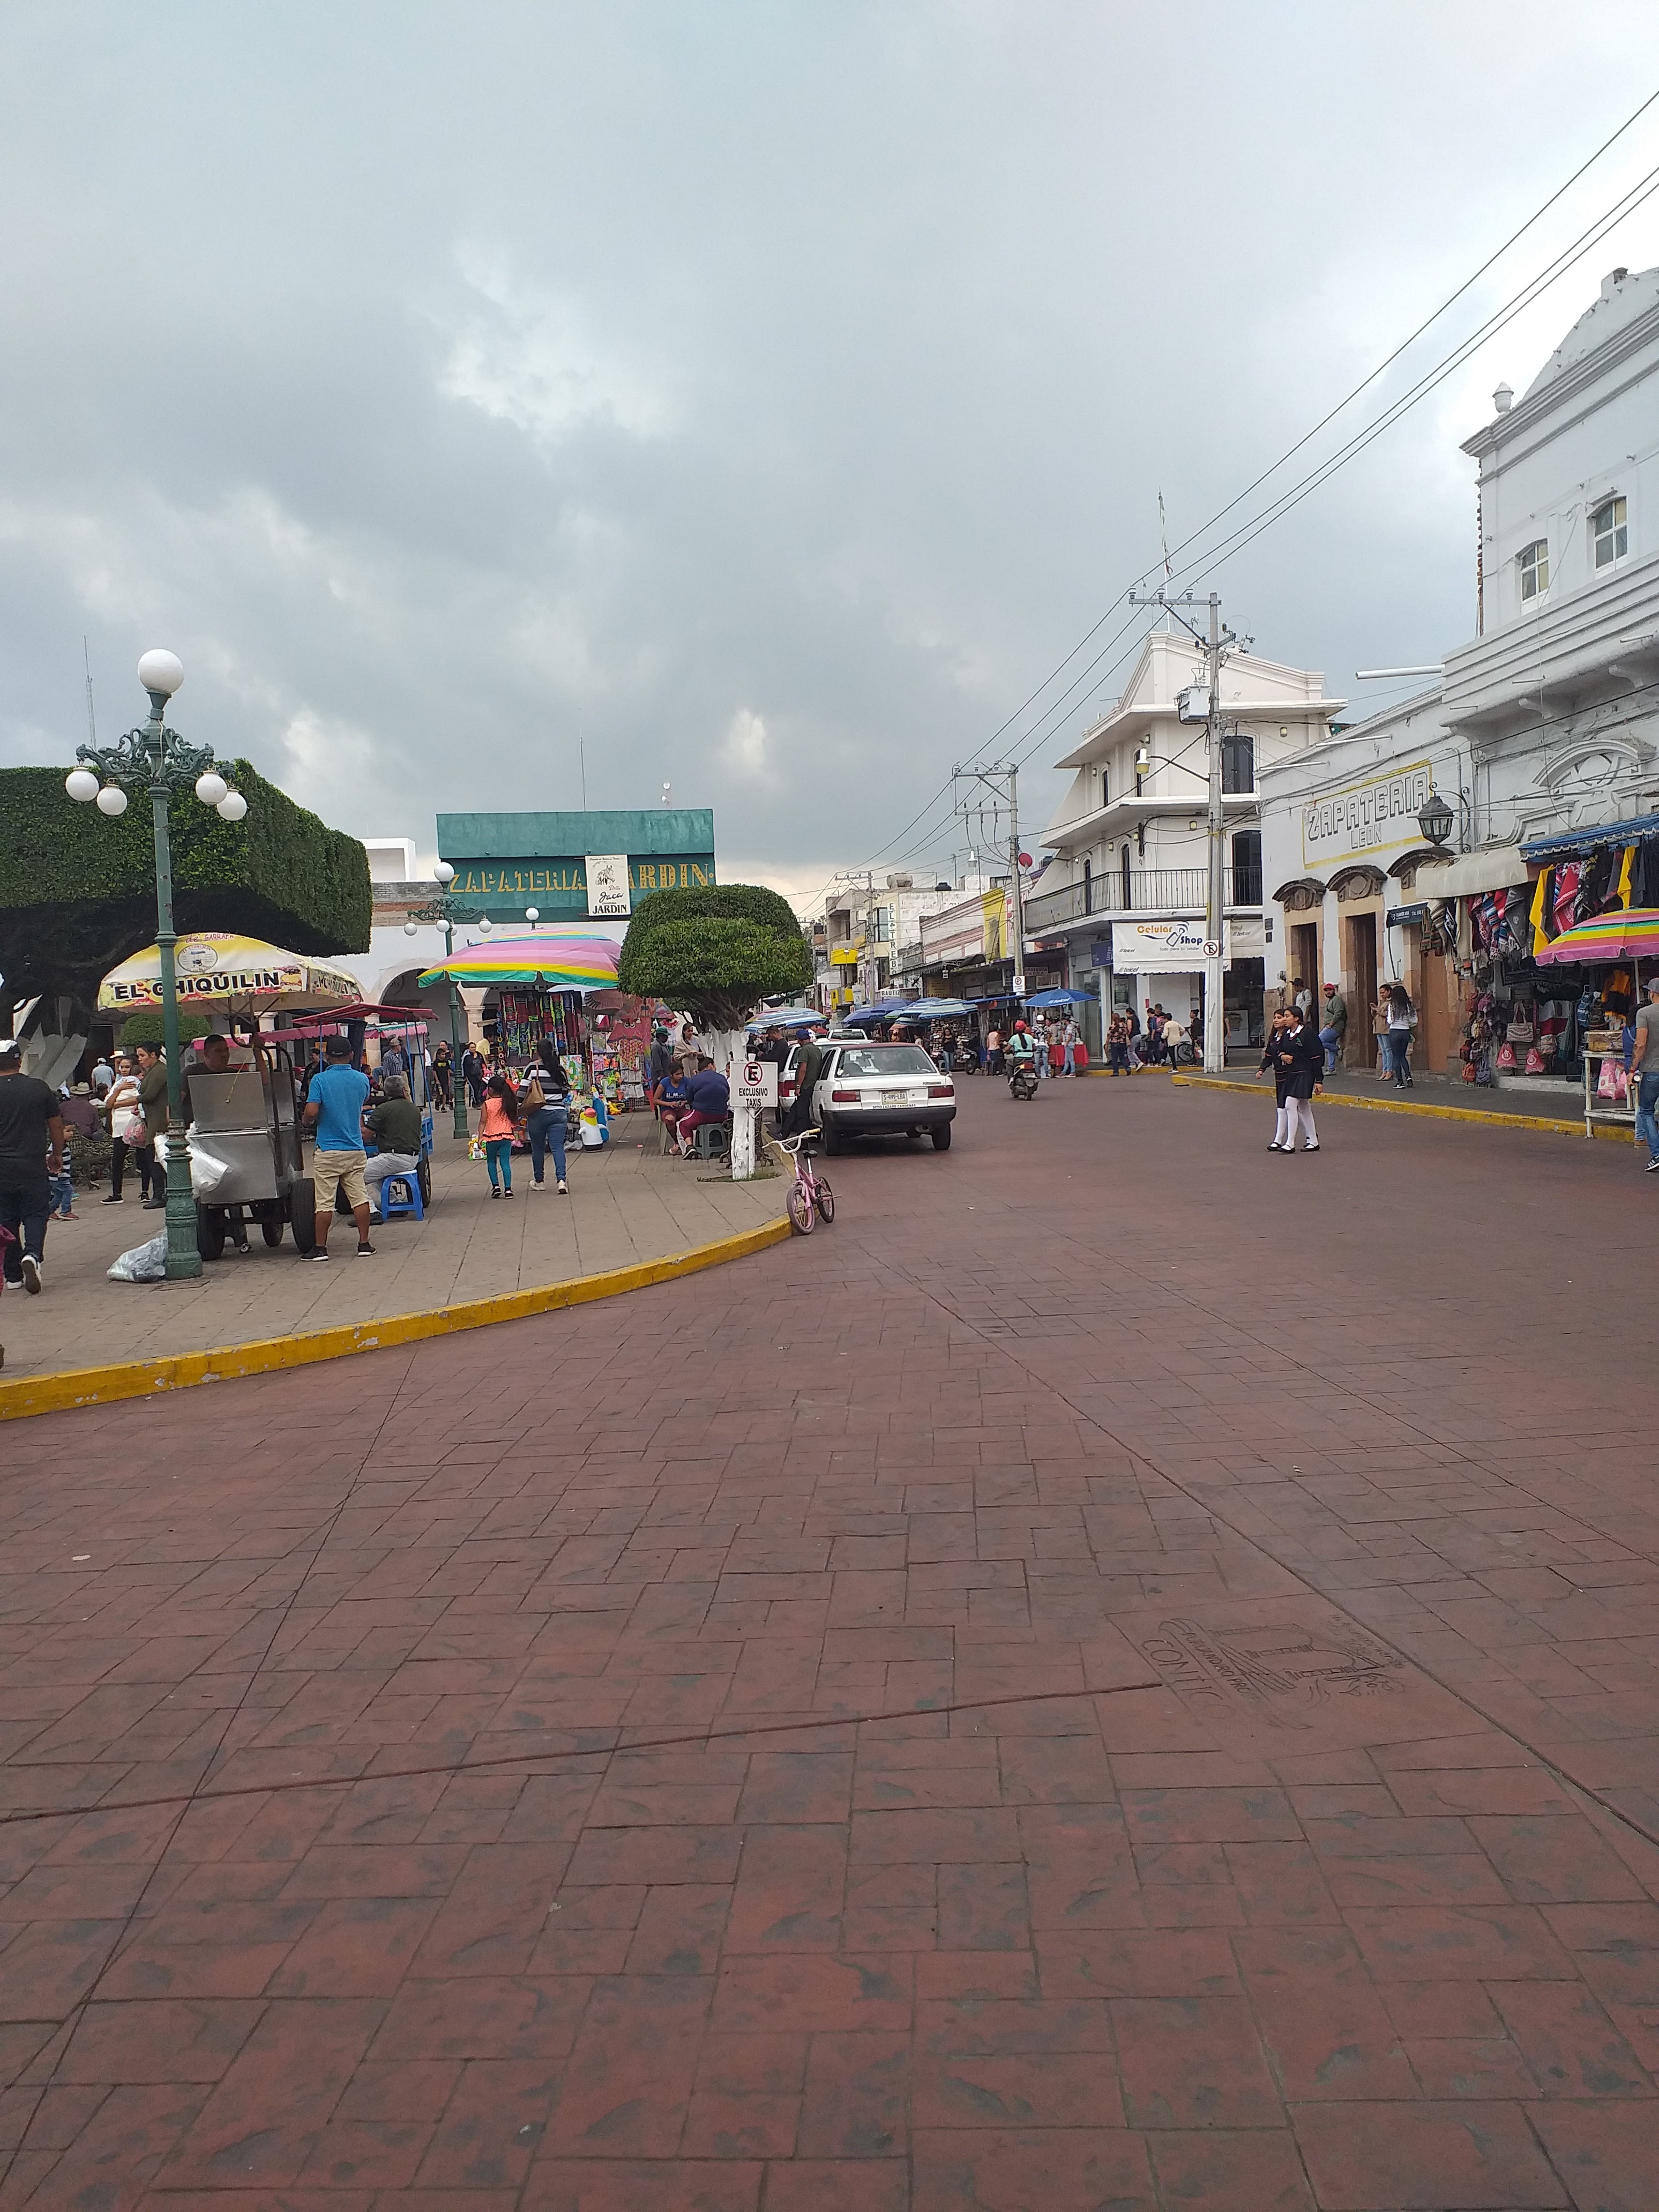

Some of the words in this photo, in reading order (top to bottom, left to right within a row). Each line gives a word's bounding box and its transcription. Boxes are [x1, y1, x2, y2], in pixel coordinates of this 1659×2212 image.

[1308, 771, 1428, 841] ZAPATERIA
[1351, 823, 1382, 849] LEON
[450, 869, 587, 894] ZAPATERIA
[628, 863, 709, 890] ARDIN
[593, 904, 627, 914] JARDIN
[889, 903, 895, 920] EL
[1137, 925, 1173, 933] Celular
[185, 935, 200, 943] de
[1180, 936, 1203, 946] Shop
[115, 985, 145, 1000] EL
[738, 1088, 768, 1097] EXCLUSIVO
[746, 1098, 761, 1107] TAXIS
